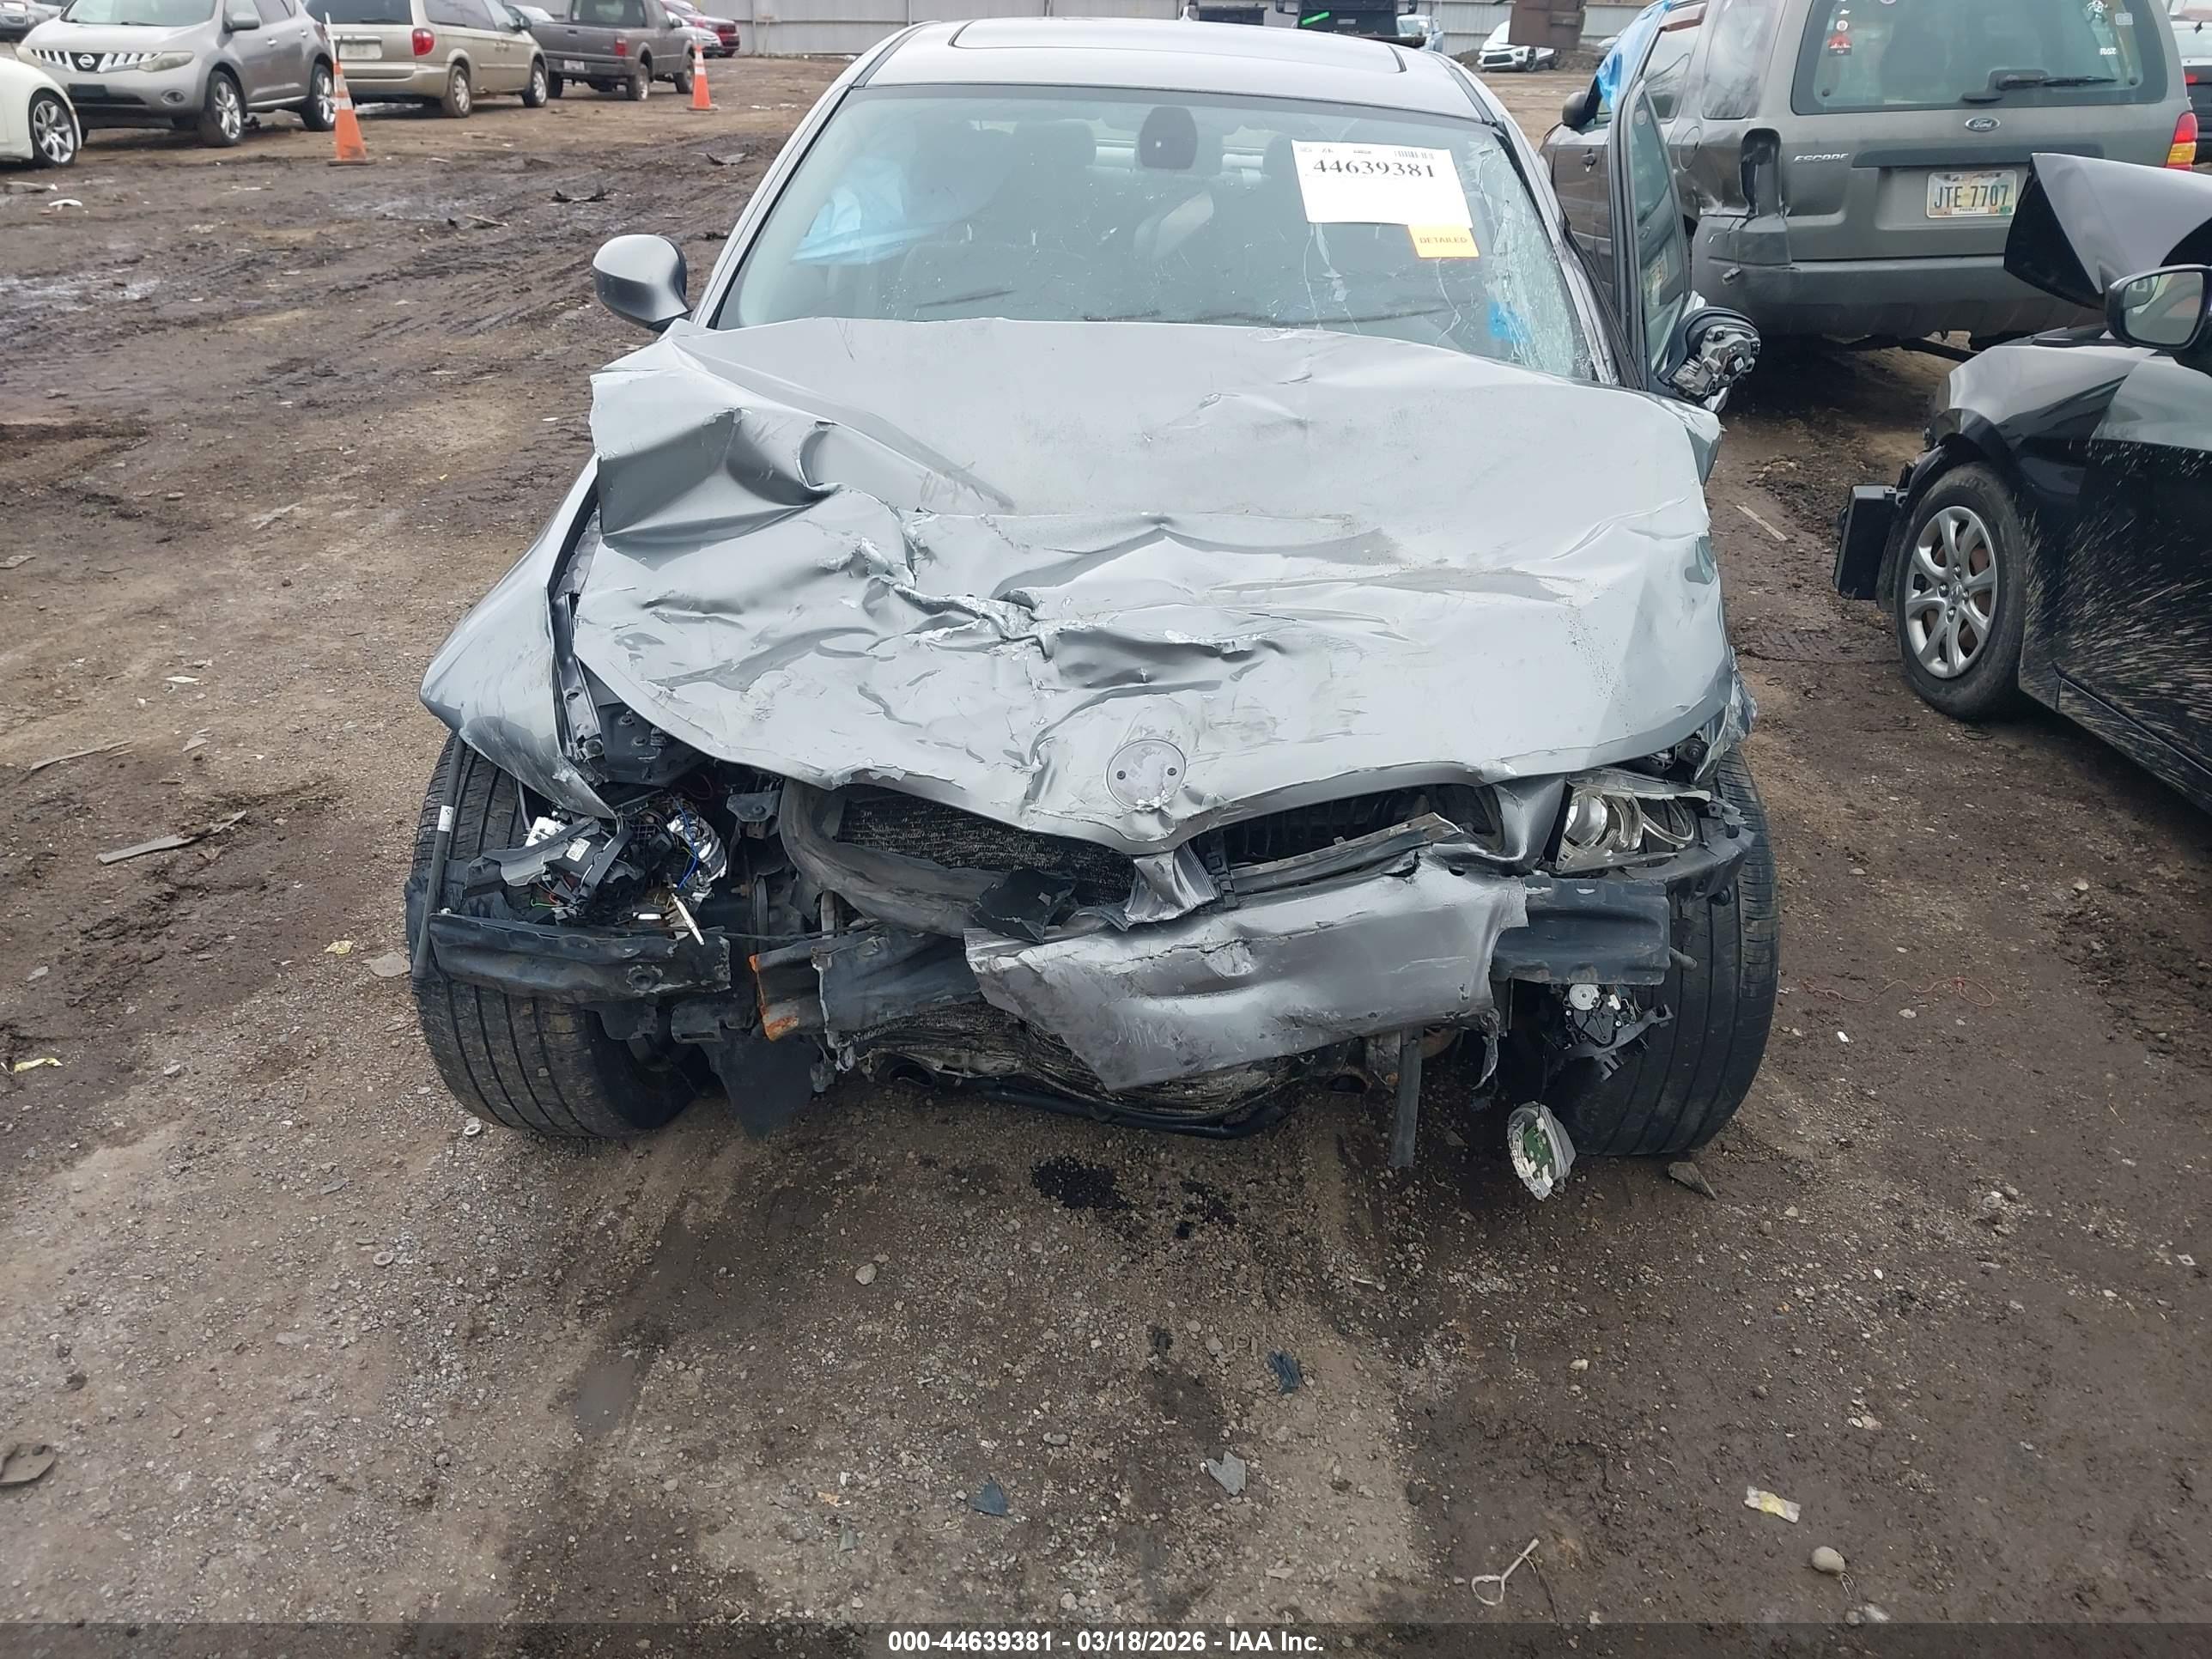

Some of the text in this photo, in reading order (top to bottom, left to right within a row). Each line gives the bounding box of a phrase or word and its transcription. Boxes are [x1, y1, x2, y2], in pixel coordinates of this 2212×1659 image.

[1973, 119, 1993, 128] Ford
[1794, 153, 1849, 163] ESCAPE
[1313, 159, 1434, 178] 44639381
[1934, 185, 2008, 209] JTE 7707
[1419, 236, 1468, 246] DETAILED
